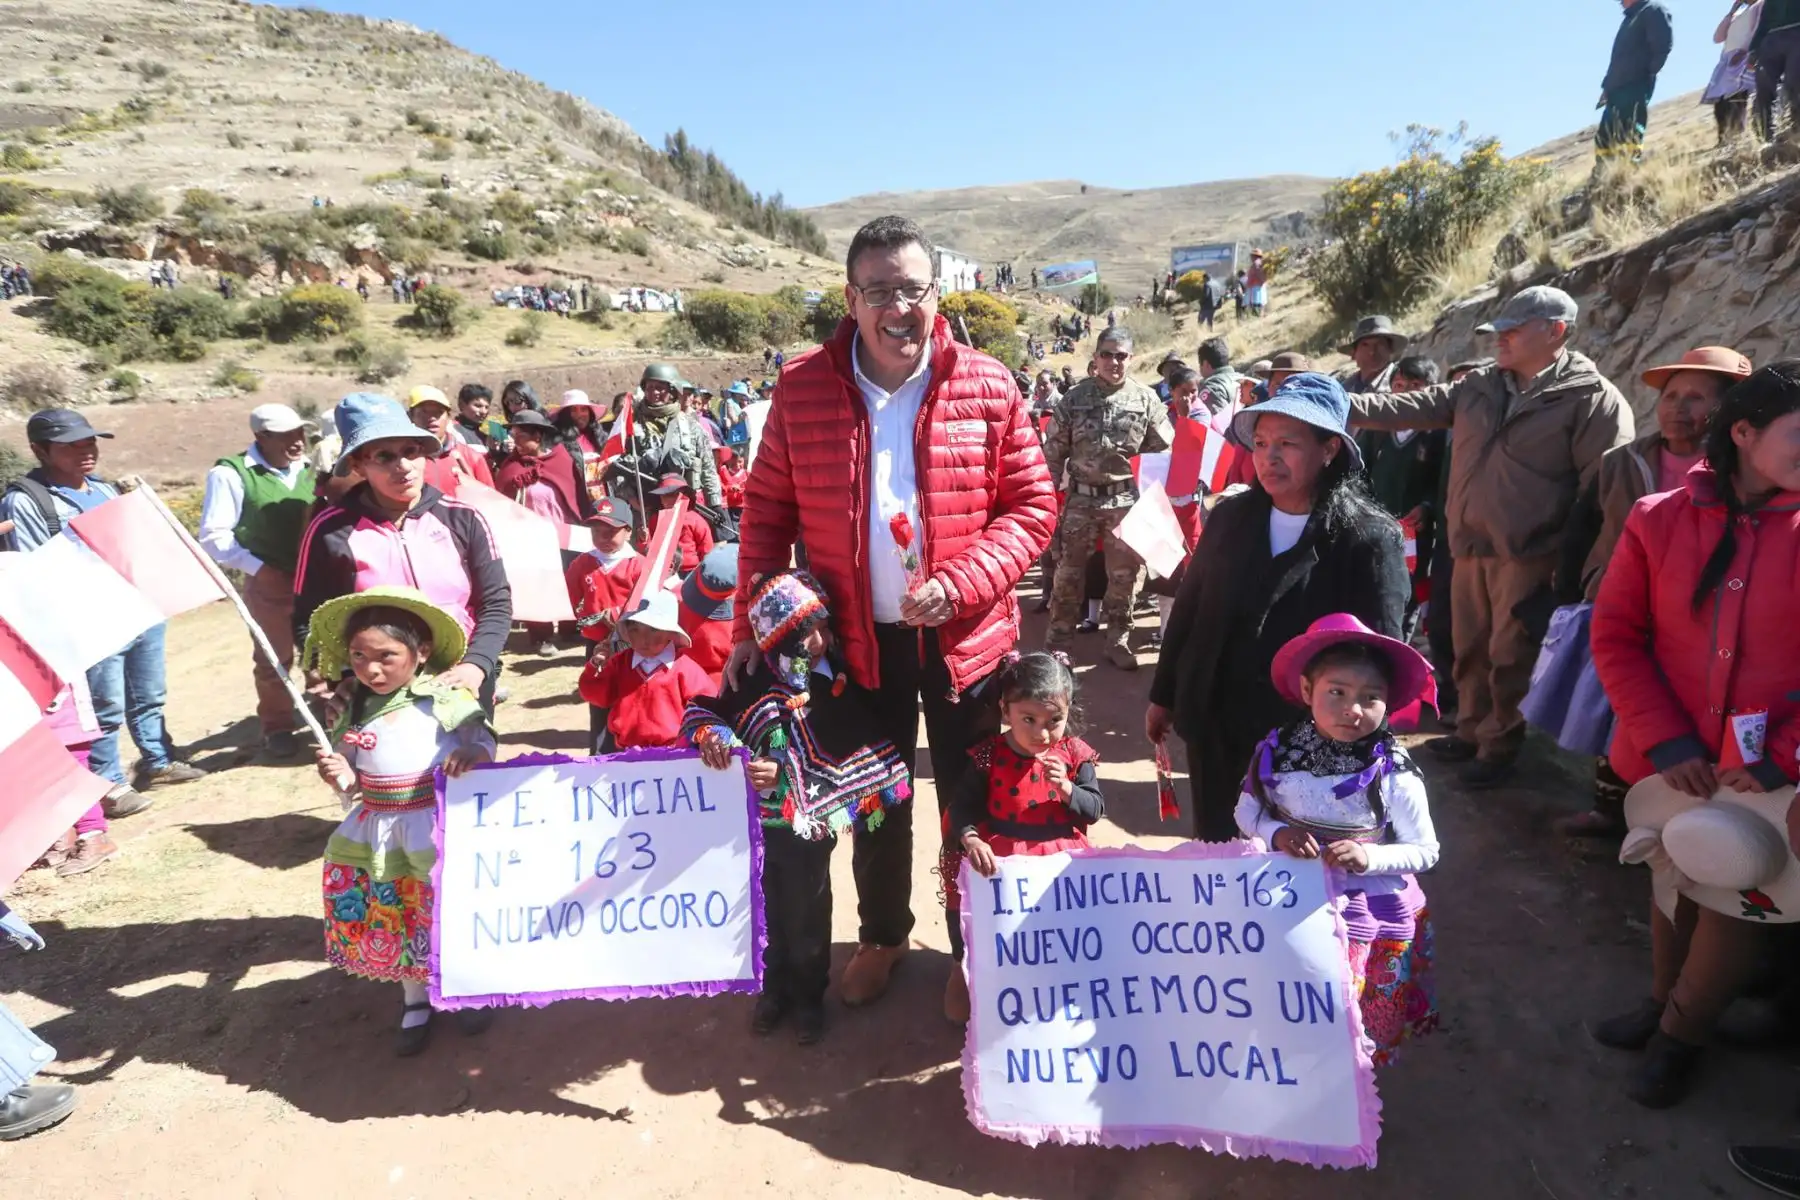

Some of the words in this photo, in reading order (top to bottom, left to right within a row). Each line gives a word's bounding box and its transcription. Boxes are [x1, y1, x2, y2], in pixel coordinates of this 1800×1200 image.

[572, 776, 716, 822] INICIAL
[569, 831, 657, 883] 163
[1054, 871, 1171, 911] INICIAL
[1236, 869, 1299, 909] 163
[472, 900, 585, 950] NUEVO
[600, 890, 729, 935] OCCORO
[994, 925, 1103, 967] NUEVO
[1131, 920, 1266, 957] OCCORO
[998, 973, 1253, 1027] QUEREMOS
[1277, 980, 1336, 1025] UN
[1006, 1043, 1139, 1084] NUEVO
[1168, 1040, 1299, 1086] LOCAL
